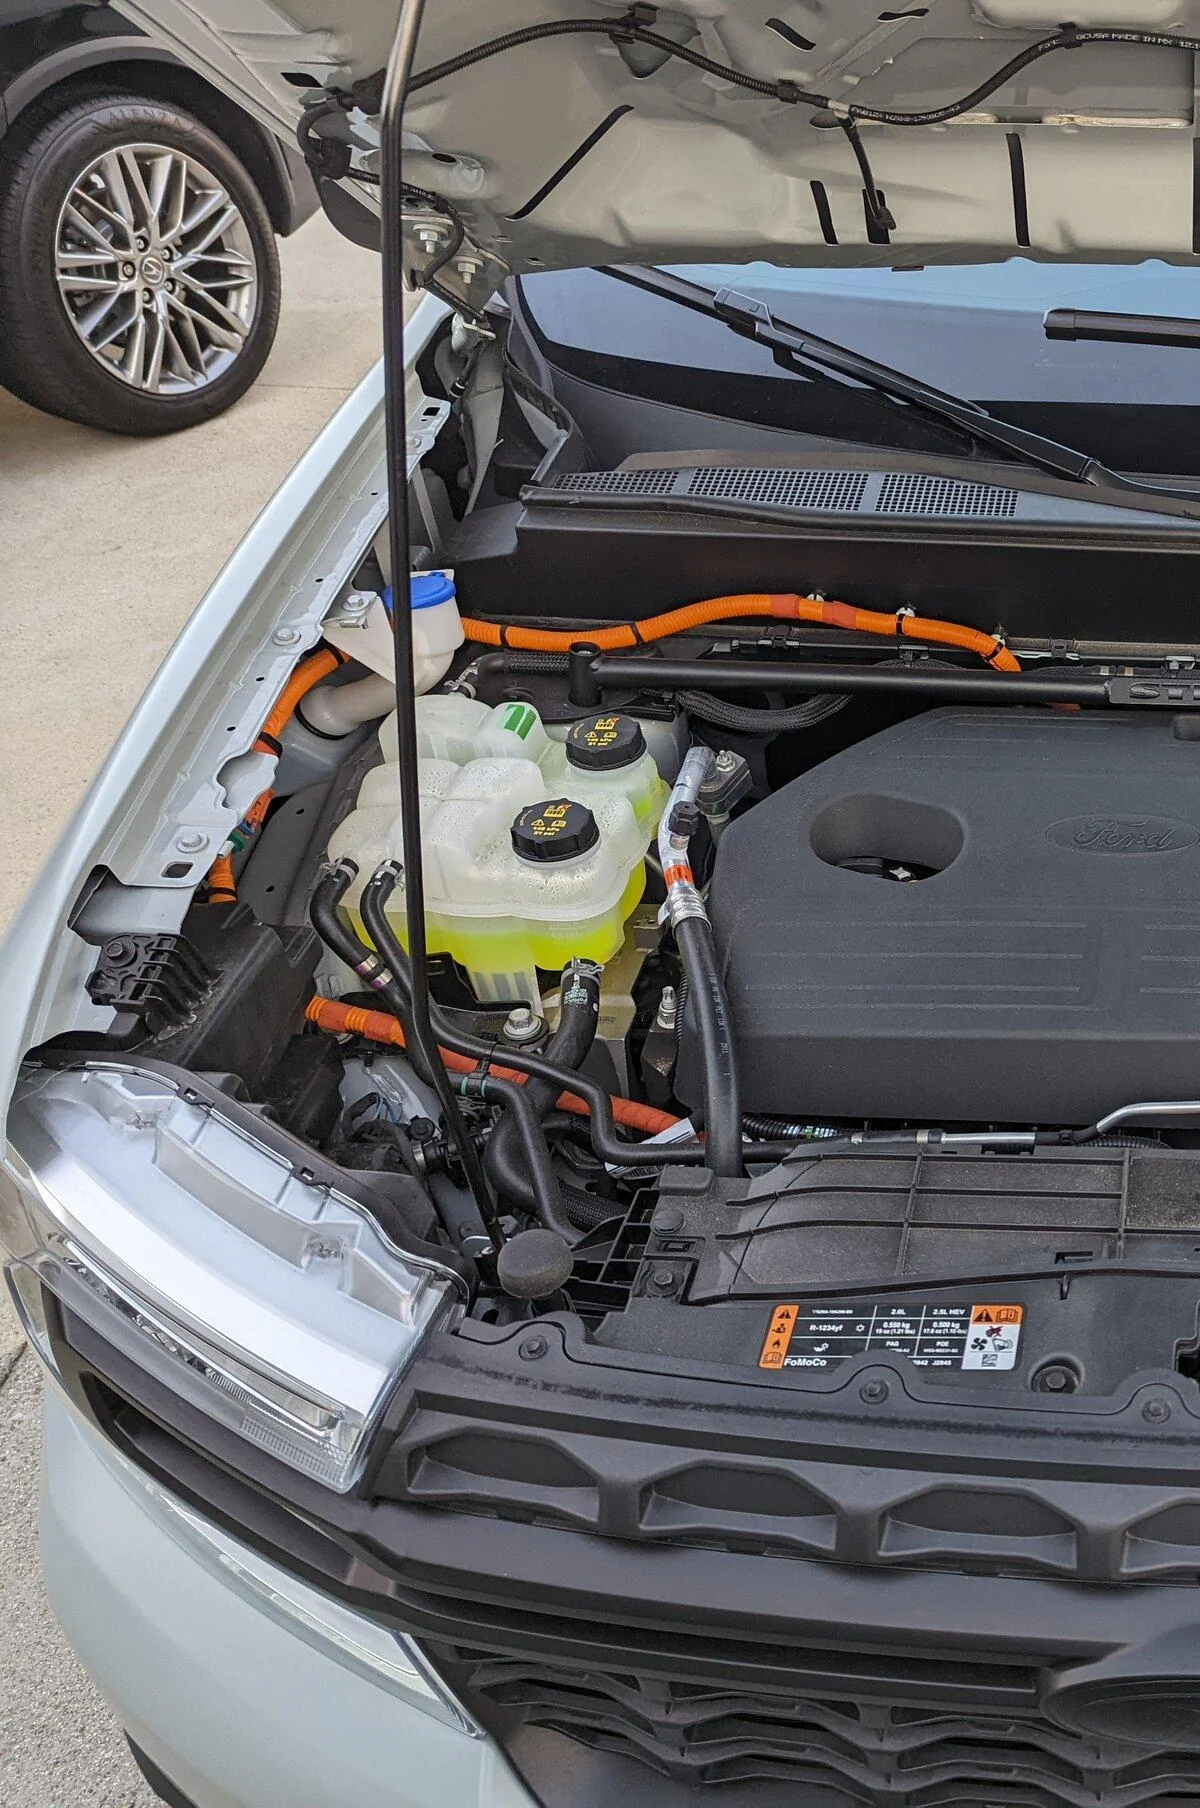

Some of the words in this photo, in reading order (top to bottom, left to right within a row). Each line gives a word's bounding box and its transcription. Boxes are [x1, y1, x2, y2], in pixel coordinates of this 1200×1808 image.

[1112, 32, 1139, 41] MADE
[1157, 38, 1172, 46] MX
[1073, 819, 1176, 849] Ford
[809, 1324, 843, 1333] R-1234yf
[902, 1321, 911, 1329] kg
[951, 1321, 960, 1329] kg
[784, 1358, 827, 1367] FoMoCo
